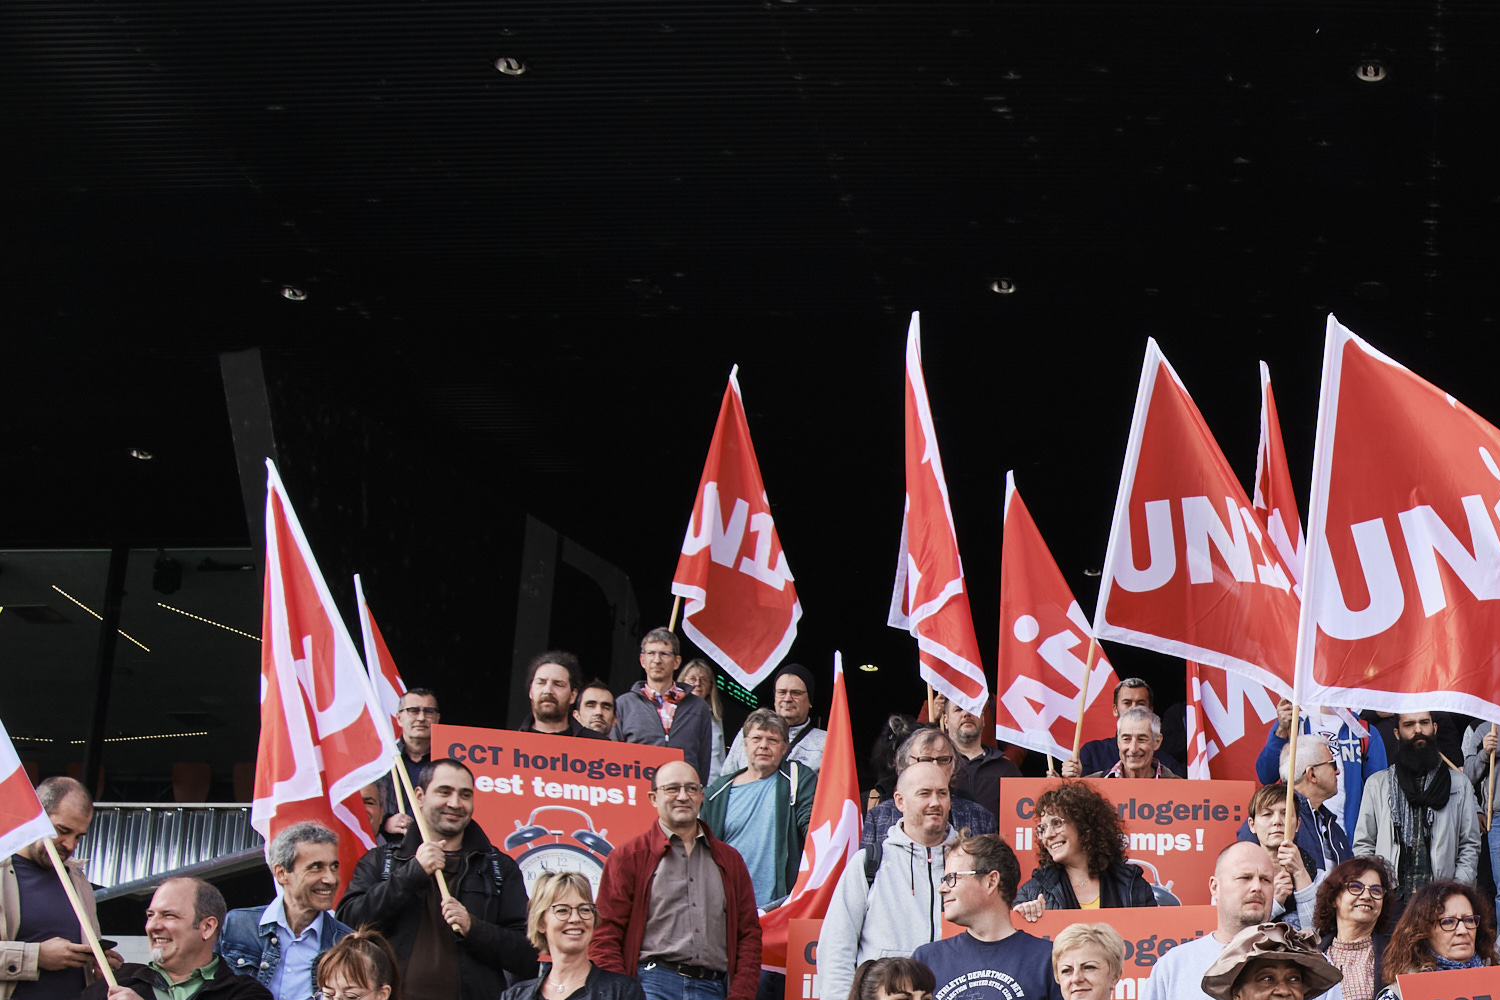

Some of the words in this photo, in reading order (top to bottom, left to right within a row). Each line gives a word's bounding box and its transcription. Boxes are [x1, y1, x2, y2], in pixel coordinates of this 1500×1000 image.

[448, 743, 503, 765] CCT
[513, 747, 655, 780] horlogerie
[475, 775, 524, 795] est
[532, 776, 638, 806] temps!
[1119, 798, 1241, 825] rlogerie:
[1015, 827, 1033, 850] il
[935, 975, 968, 1000] ATHLETIC
[967, 969, 1015, 985] DEPARTMENT
[1010, 982, 1025, 998] NEW
